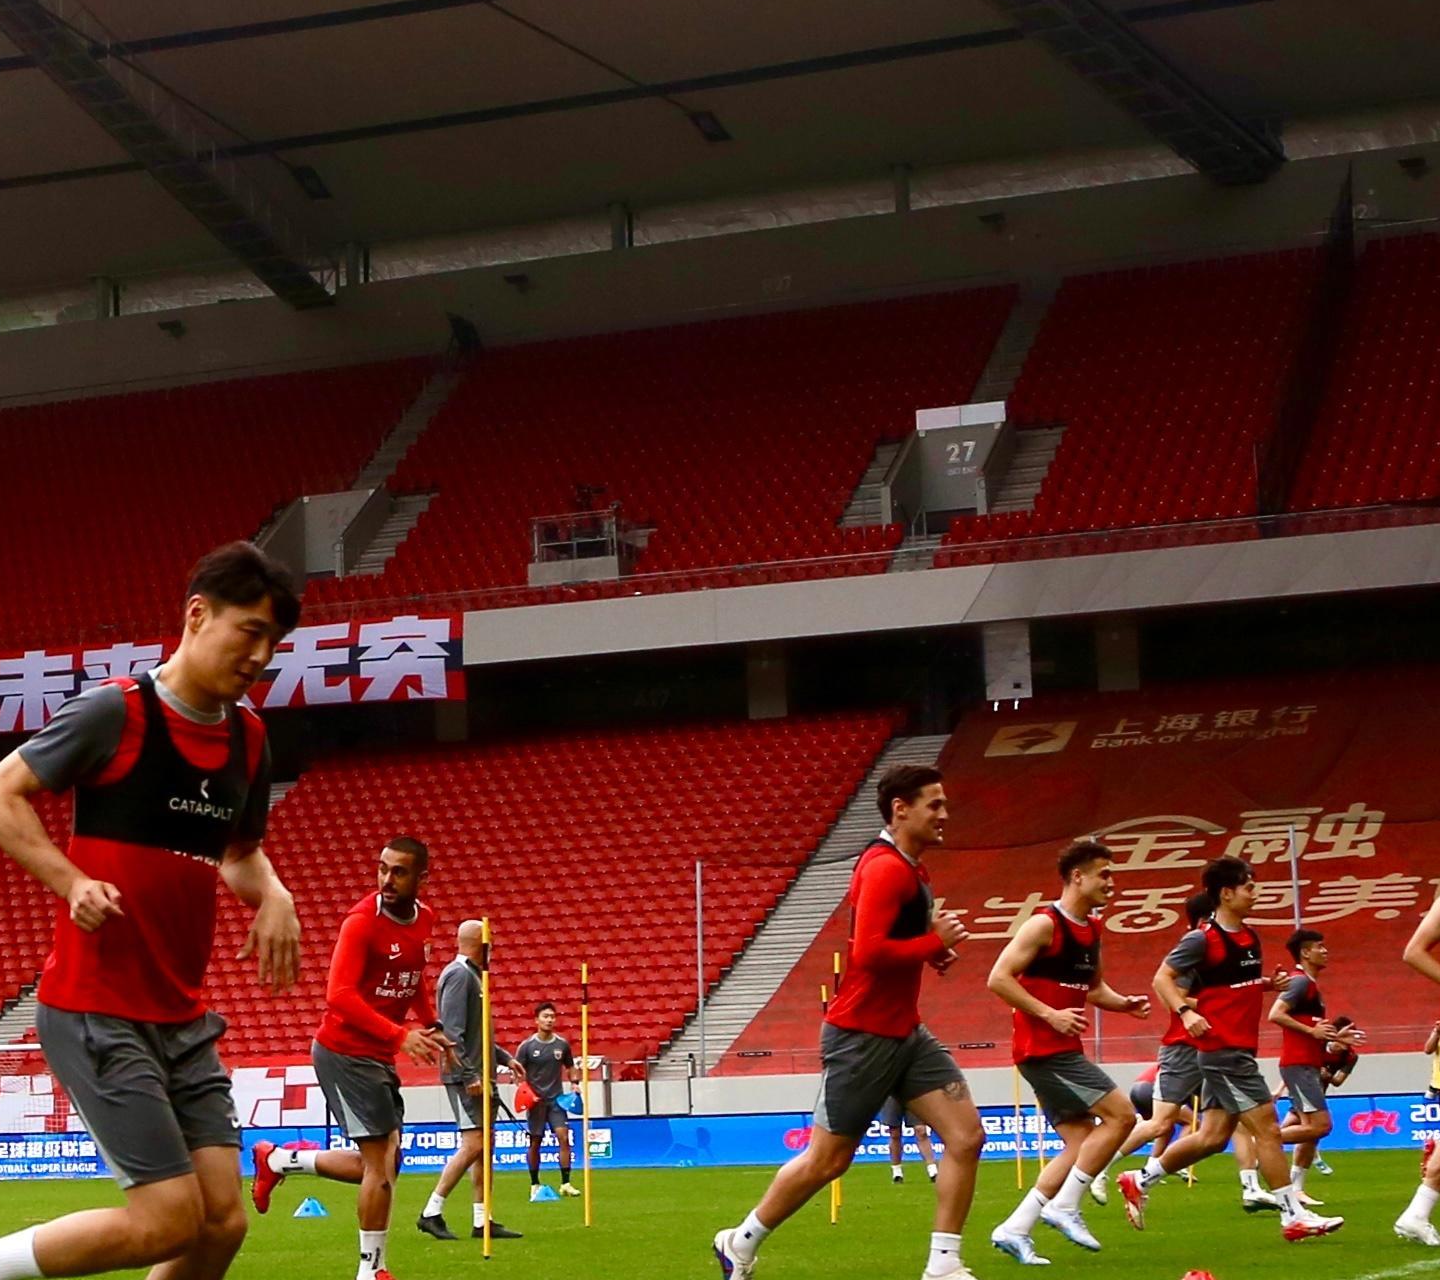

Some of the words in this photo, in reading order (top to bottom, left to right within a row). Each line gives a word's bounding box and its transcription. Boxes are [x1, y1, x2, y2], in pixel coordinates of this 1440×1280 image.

[945, 440, 977, 464] 27
[1096, 705, 1318, 737] 上海银行
[1090, 734, 1154, 749] Bank
[1158, 732, 1186, 744] of
[1192, 726, 1309, 741] Shanghai
[169, 797, 234, 821] CATAPULT
[1073, 802, 1387, 872] 金融
[31, 1163, 60, 1172] SUPER
[62, 1163, 97, 1172] LEAGUE
[403, 1155, 445, 1165] CHINESE
[500, 1153, 527, 1163] SUPE
